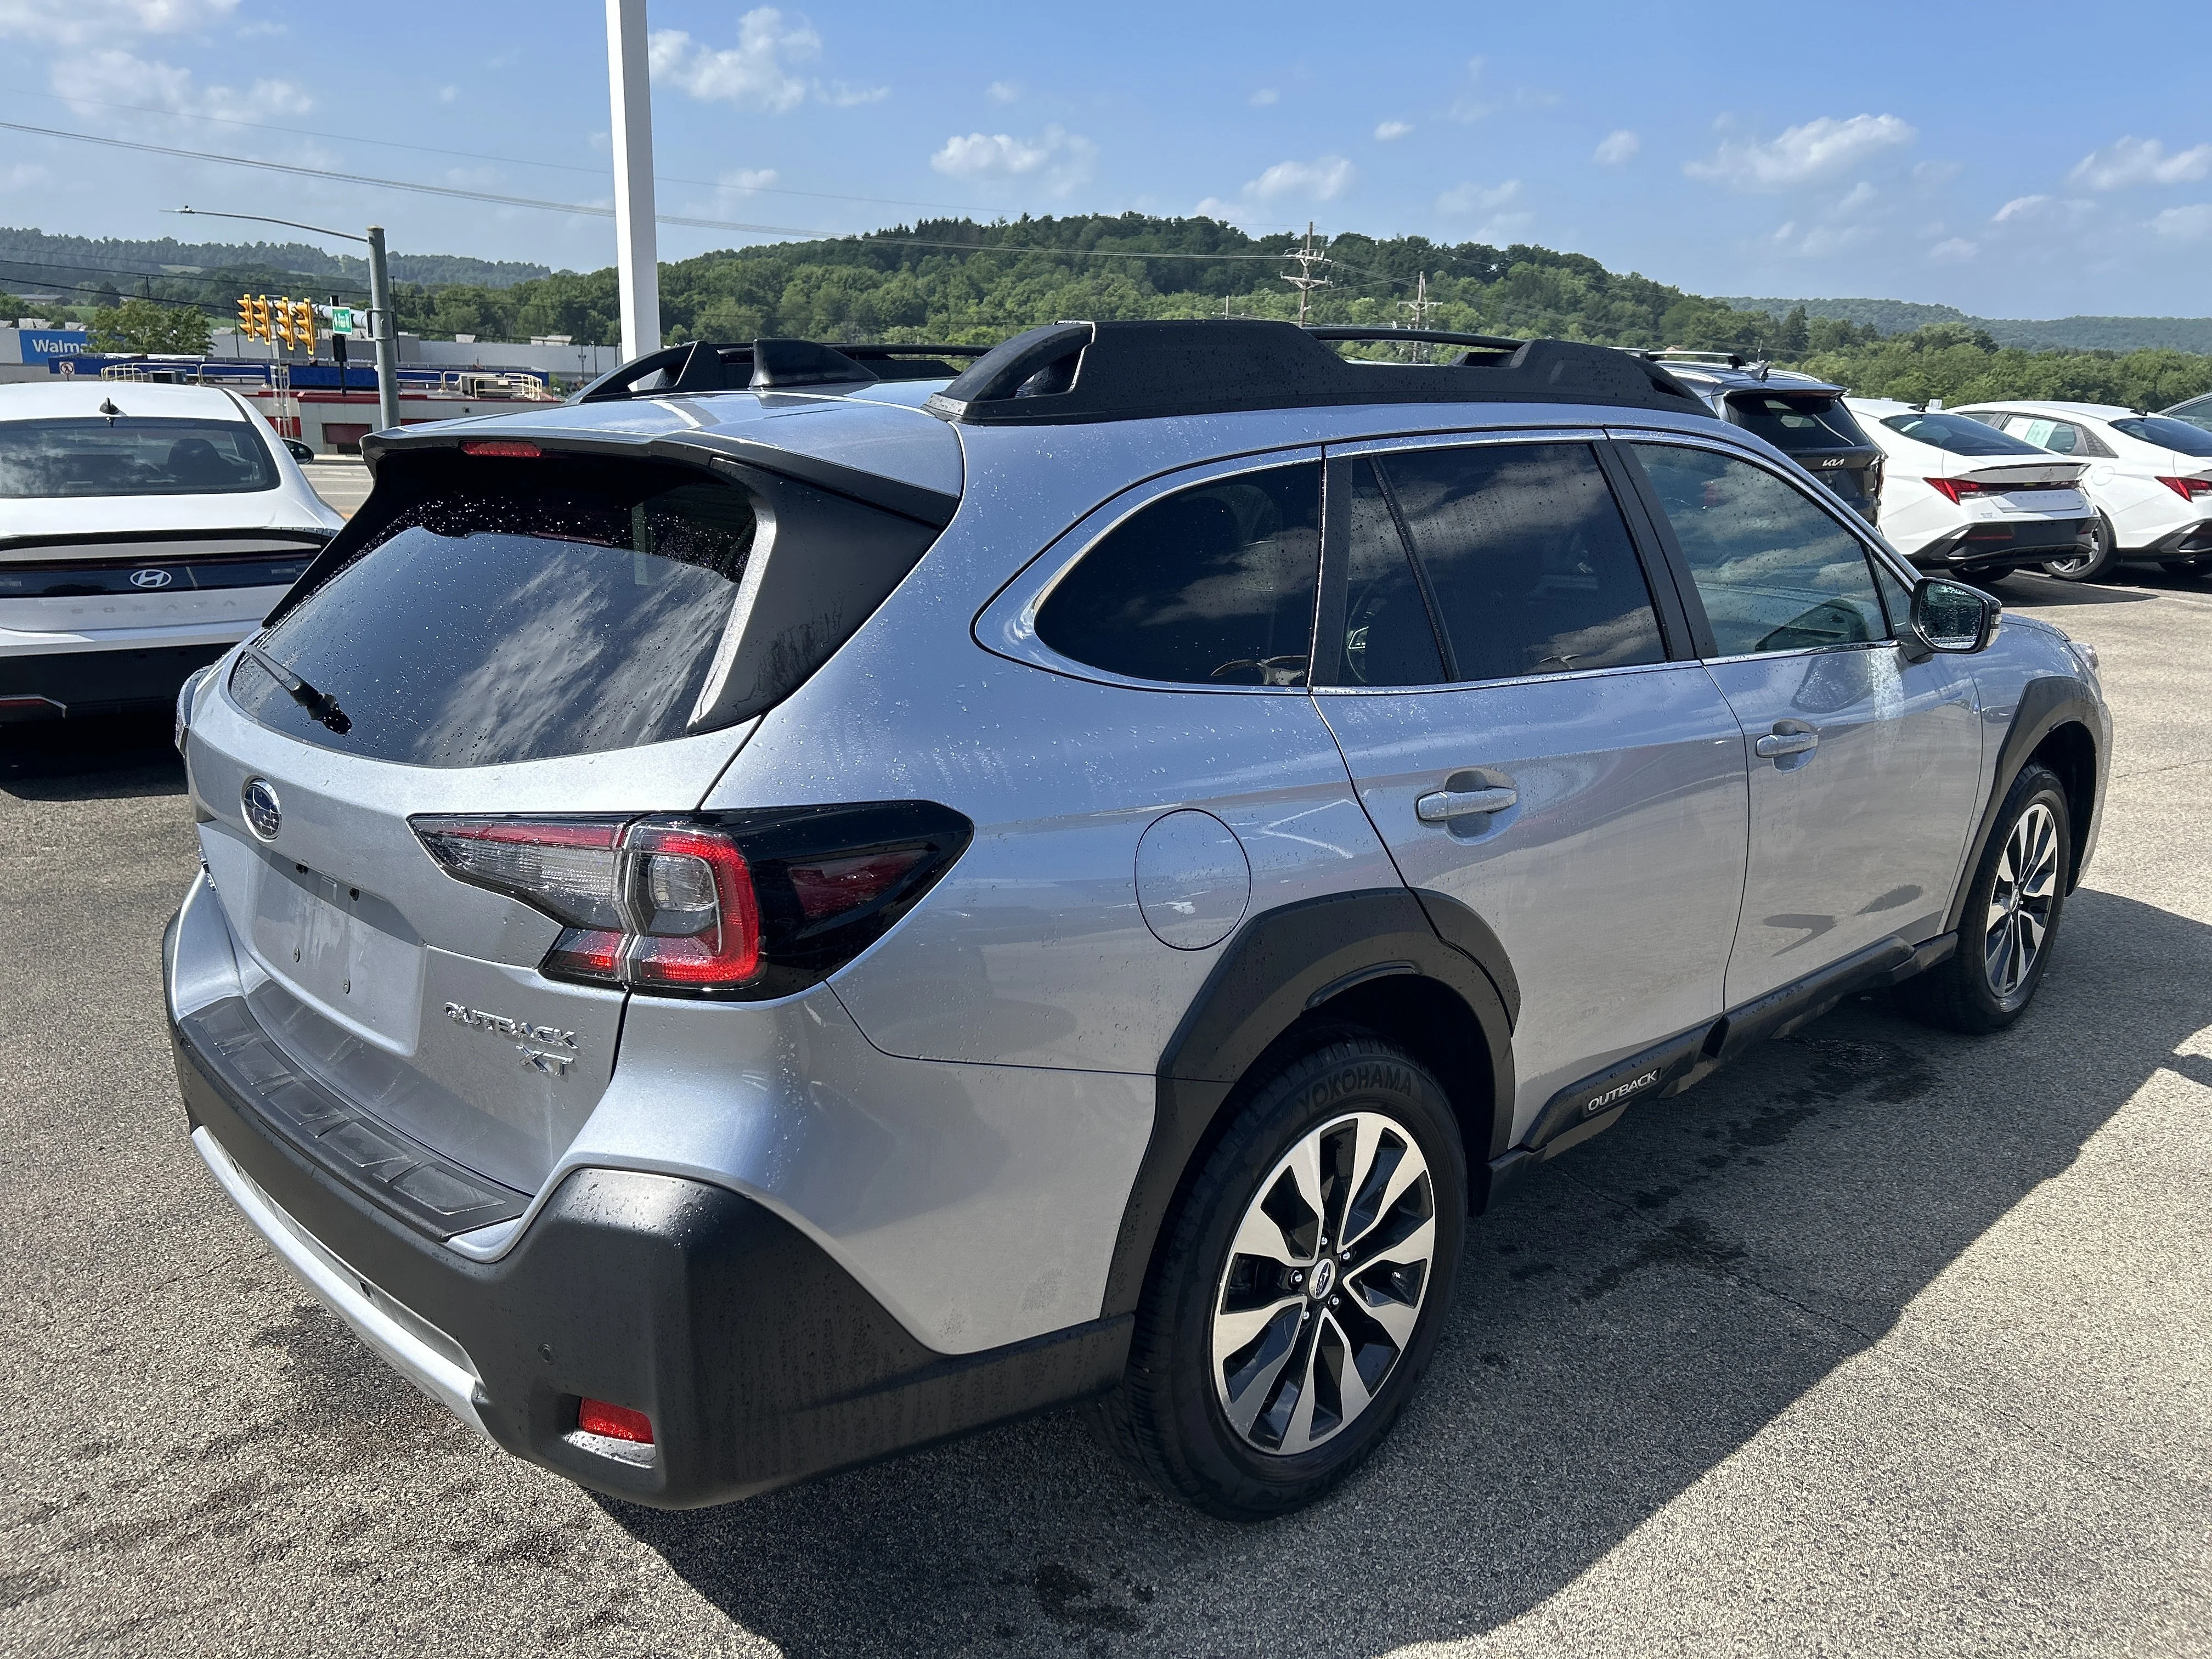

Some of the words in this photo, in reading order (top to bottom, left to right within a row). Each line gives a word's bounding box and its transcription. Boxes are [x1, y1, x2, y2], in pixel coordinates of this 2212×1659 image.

[32, 339, 92, 354] Walm
[443, 1002, 579, 1049] OUTBACK
[515, 1045, 575, 1076] XT
[1298, 1064, 1412, 1115] YOKOHAMA
[1588, 1070, 1658, 1111] OUTBACK
